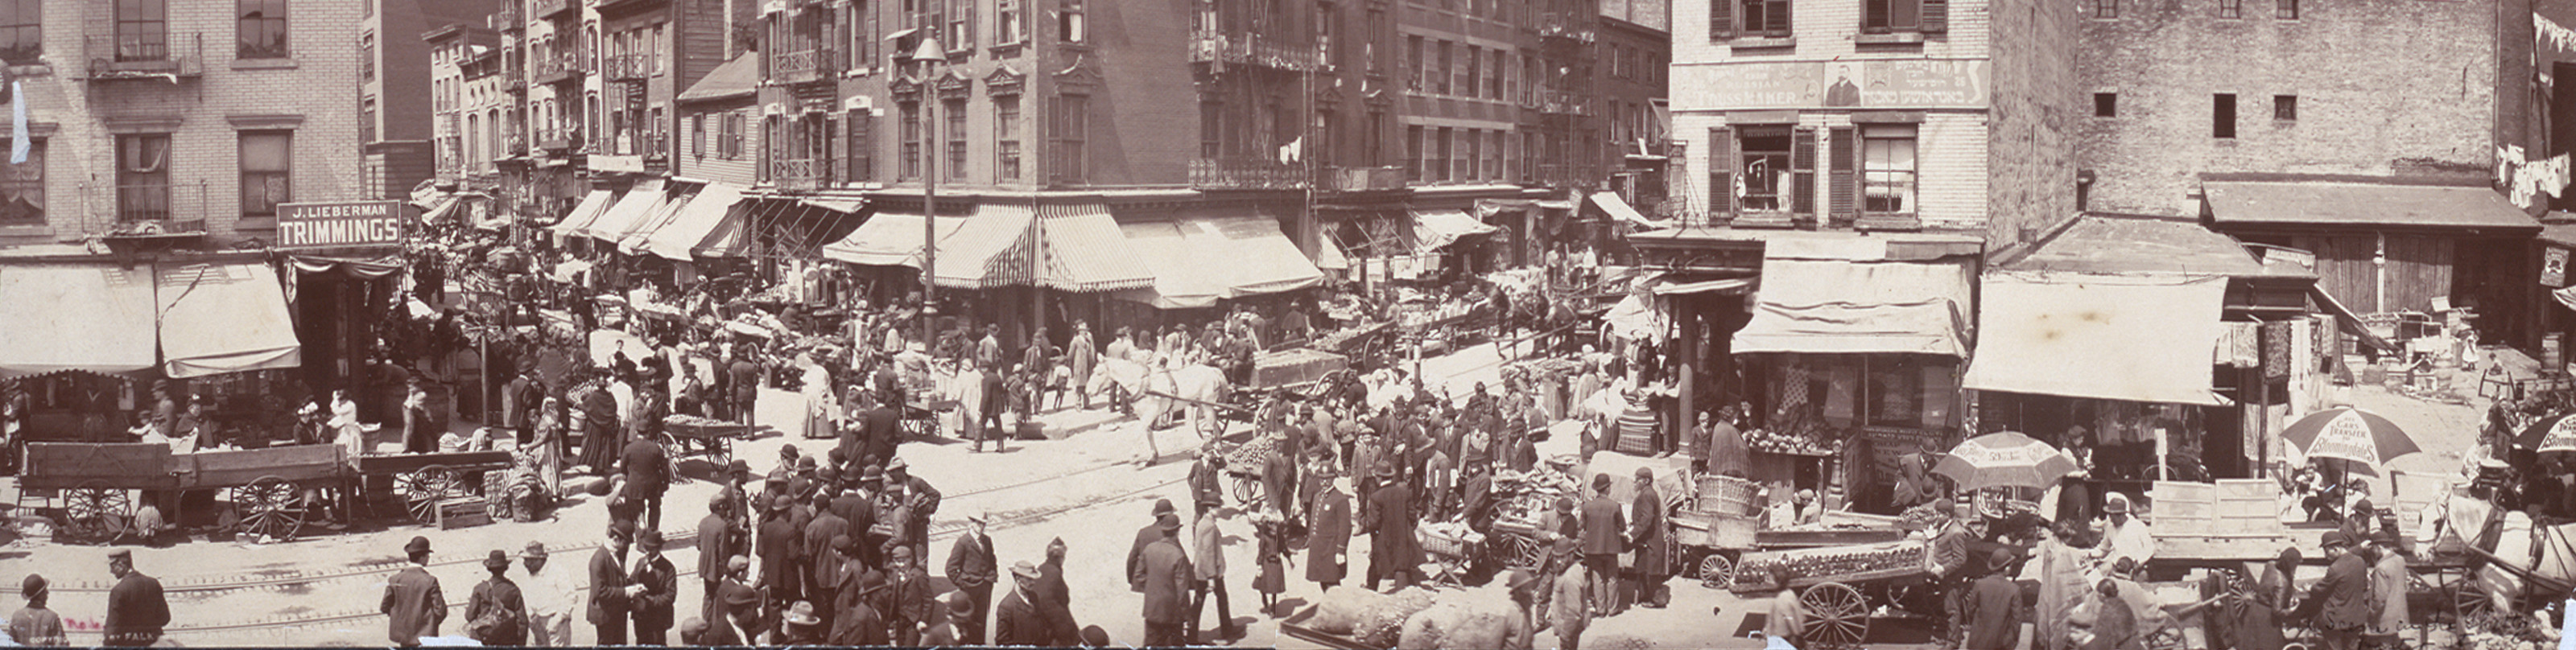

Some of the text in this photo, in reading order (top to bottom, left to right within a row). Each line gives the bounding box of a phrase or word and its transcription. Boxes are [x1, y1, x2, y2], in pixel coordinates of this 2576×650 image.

[1697, 91, 1743, 105] TRUSS
[279, 218, 398, 245] TRIMMINGS
[2336, 420, 2359, 430] CARS
[2330, 426, 2367, 438] TRANSFER
